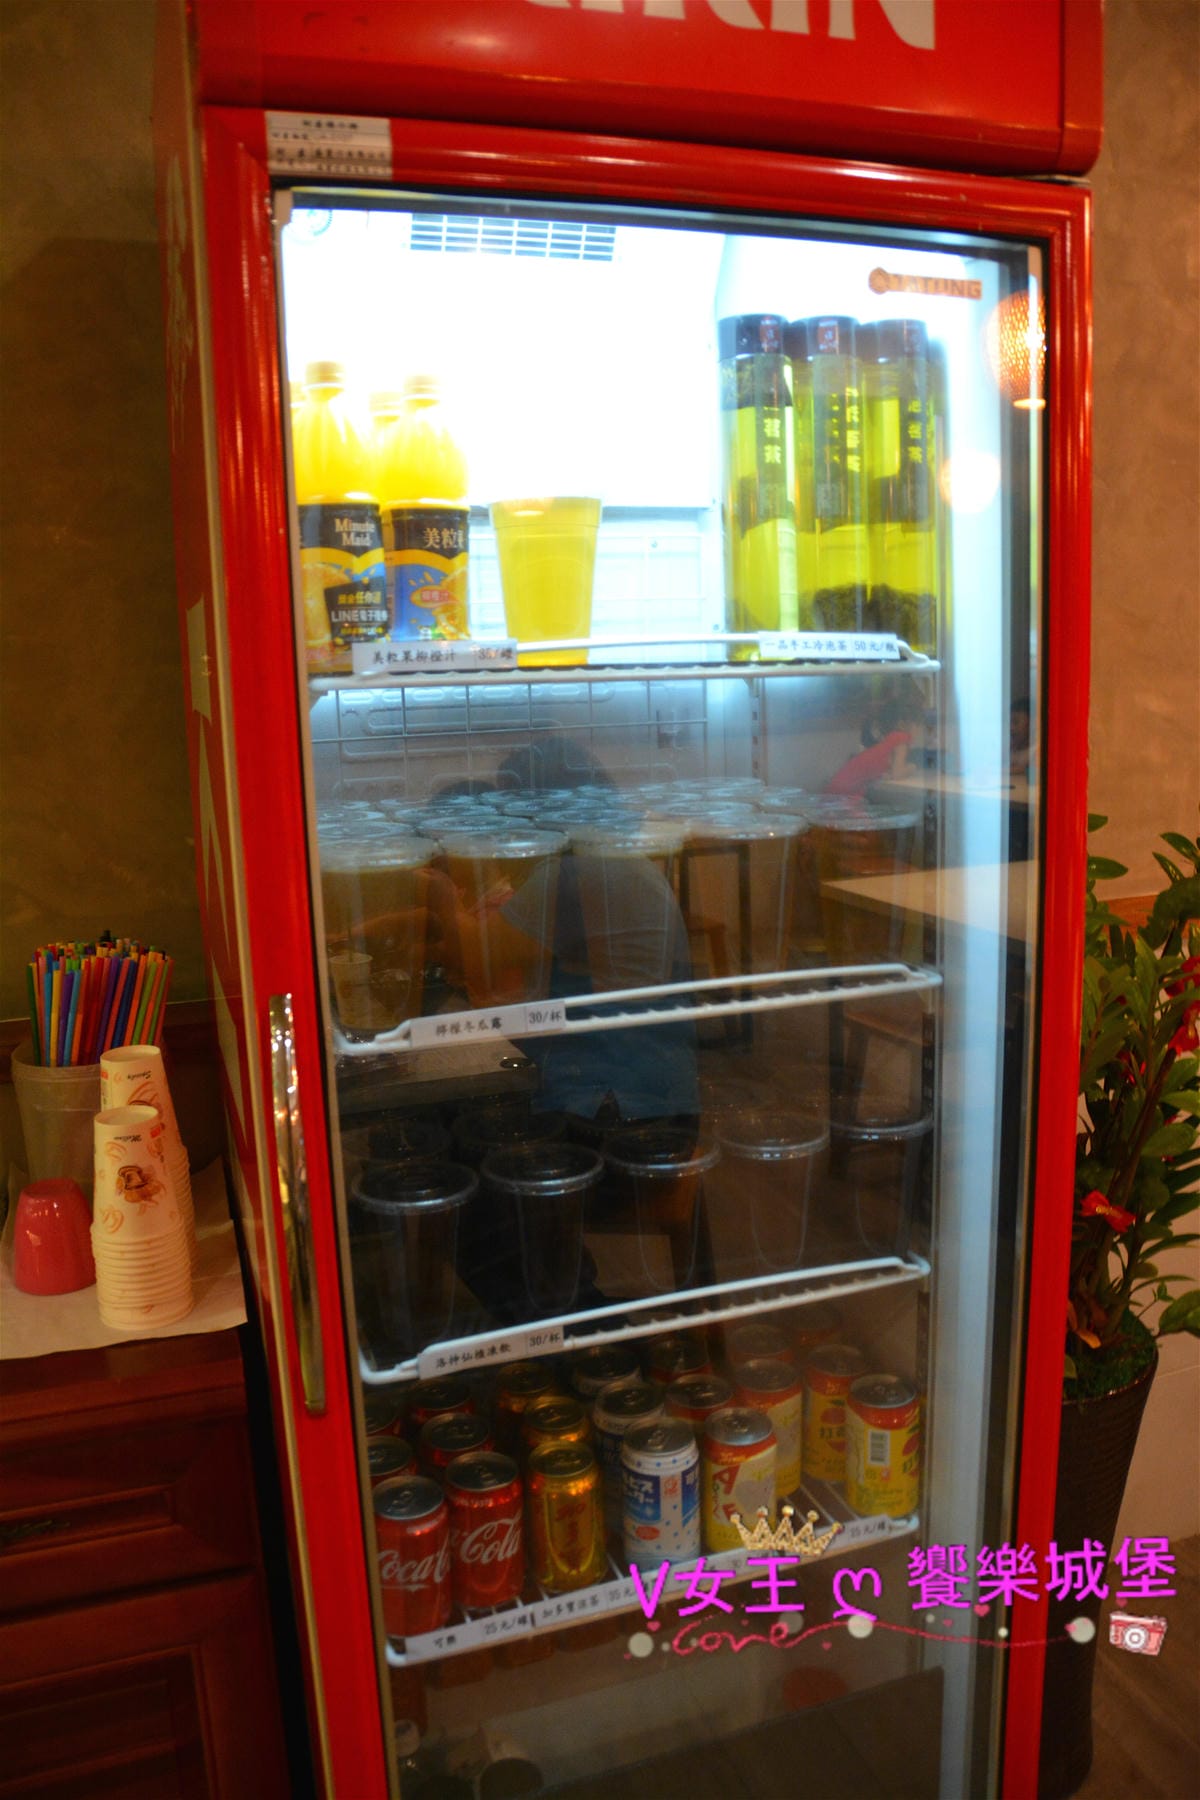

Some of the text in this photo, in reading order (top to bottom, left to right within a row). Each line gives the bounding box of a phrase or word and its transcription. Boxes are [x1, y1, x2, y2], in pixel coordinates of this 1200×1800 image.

[334, 517, 376, 533] Minute
[341, 532, 373, 547] Maid
[435, 1010, 562, 1037] 檸檬冬瓜露 30/杯
[528, 1333, 561, 1347] 30/杯
